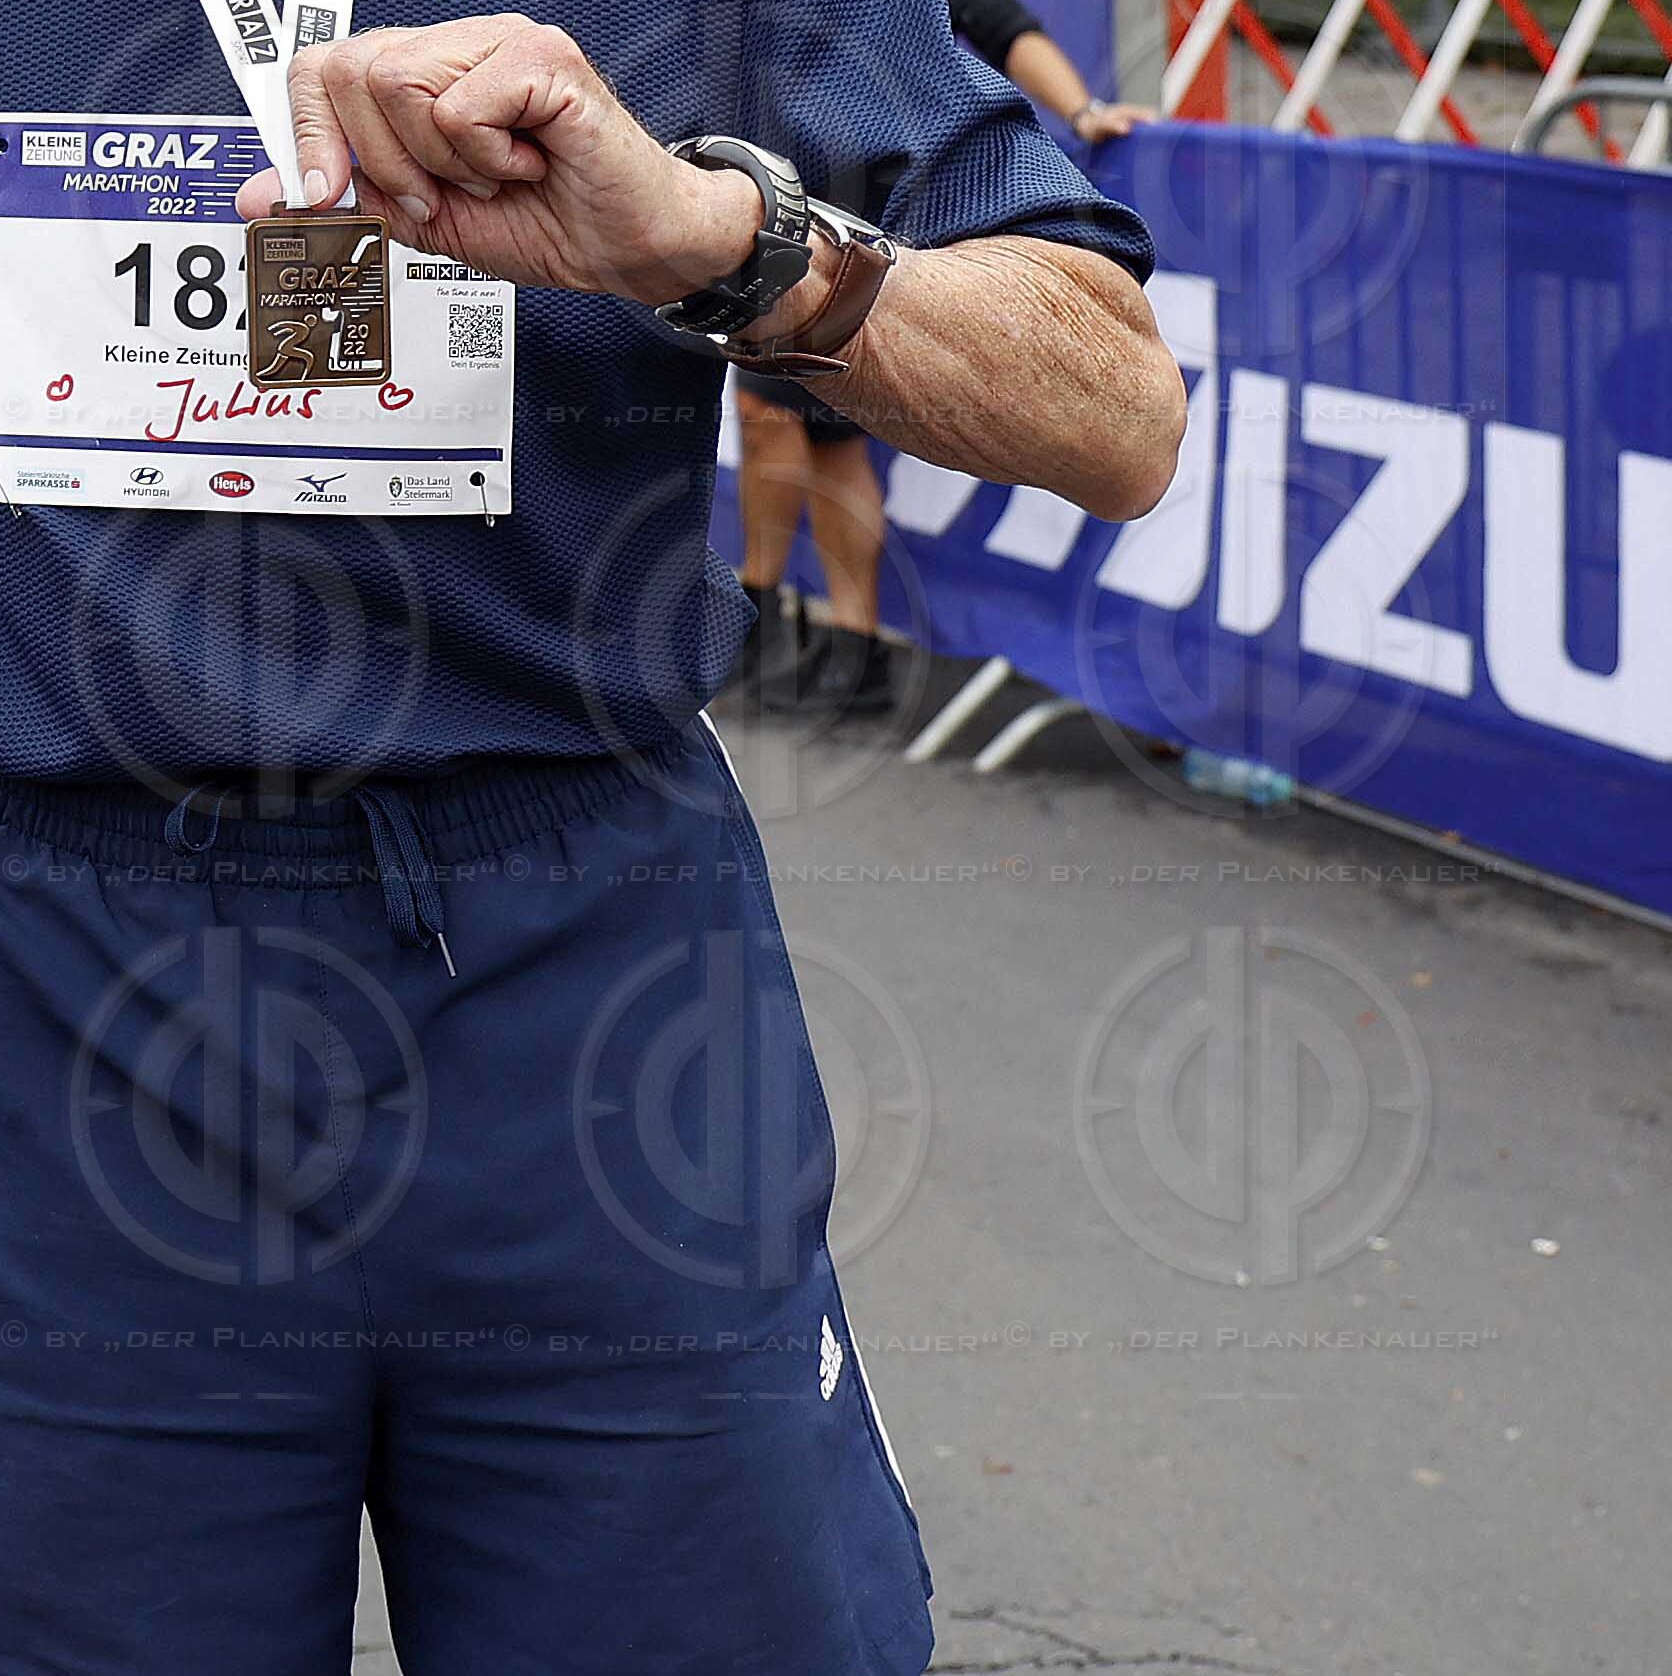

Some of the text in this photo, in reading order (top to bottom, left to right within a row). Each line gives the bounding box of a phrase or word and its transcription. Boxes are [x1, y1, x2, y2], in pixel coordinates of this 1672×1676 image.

[26, 136, 82, 148] KLEINE
[25, 149, 82, 162] ZEITUNG
[92, 131, 219, 170] GRAZ
[63, 173, 179, 193] MARATHON
[146, 197, 196, 215] 2022
[265, 240, 304, 250] KLEINE
[279, 266, 360, 290] GRAZ
[115, 242, 247, 331] 18
[260, 292, 336, 307] MARATHON
[347, 324, 369, 339] 20
[104, 344, 170, 364] Kleine
[343, 341, 367, 356] 22
[16, 479, 70, 489] SPARKASSE
[212, 476, 252, 493] Hervis
[407, 476, 450, 486] Das Land
[123, 487, 170, 498] HYUNDAI
[294, 491, 347, 503] MIZUNO
[404, 489, 450, 499] Steiermark
[883, 272, 1672, 764] MIZU
